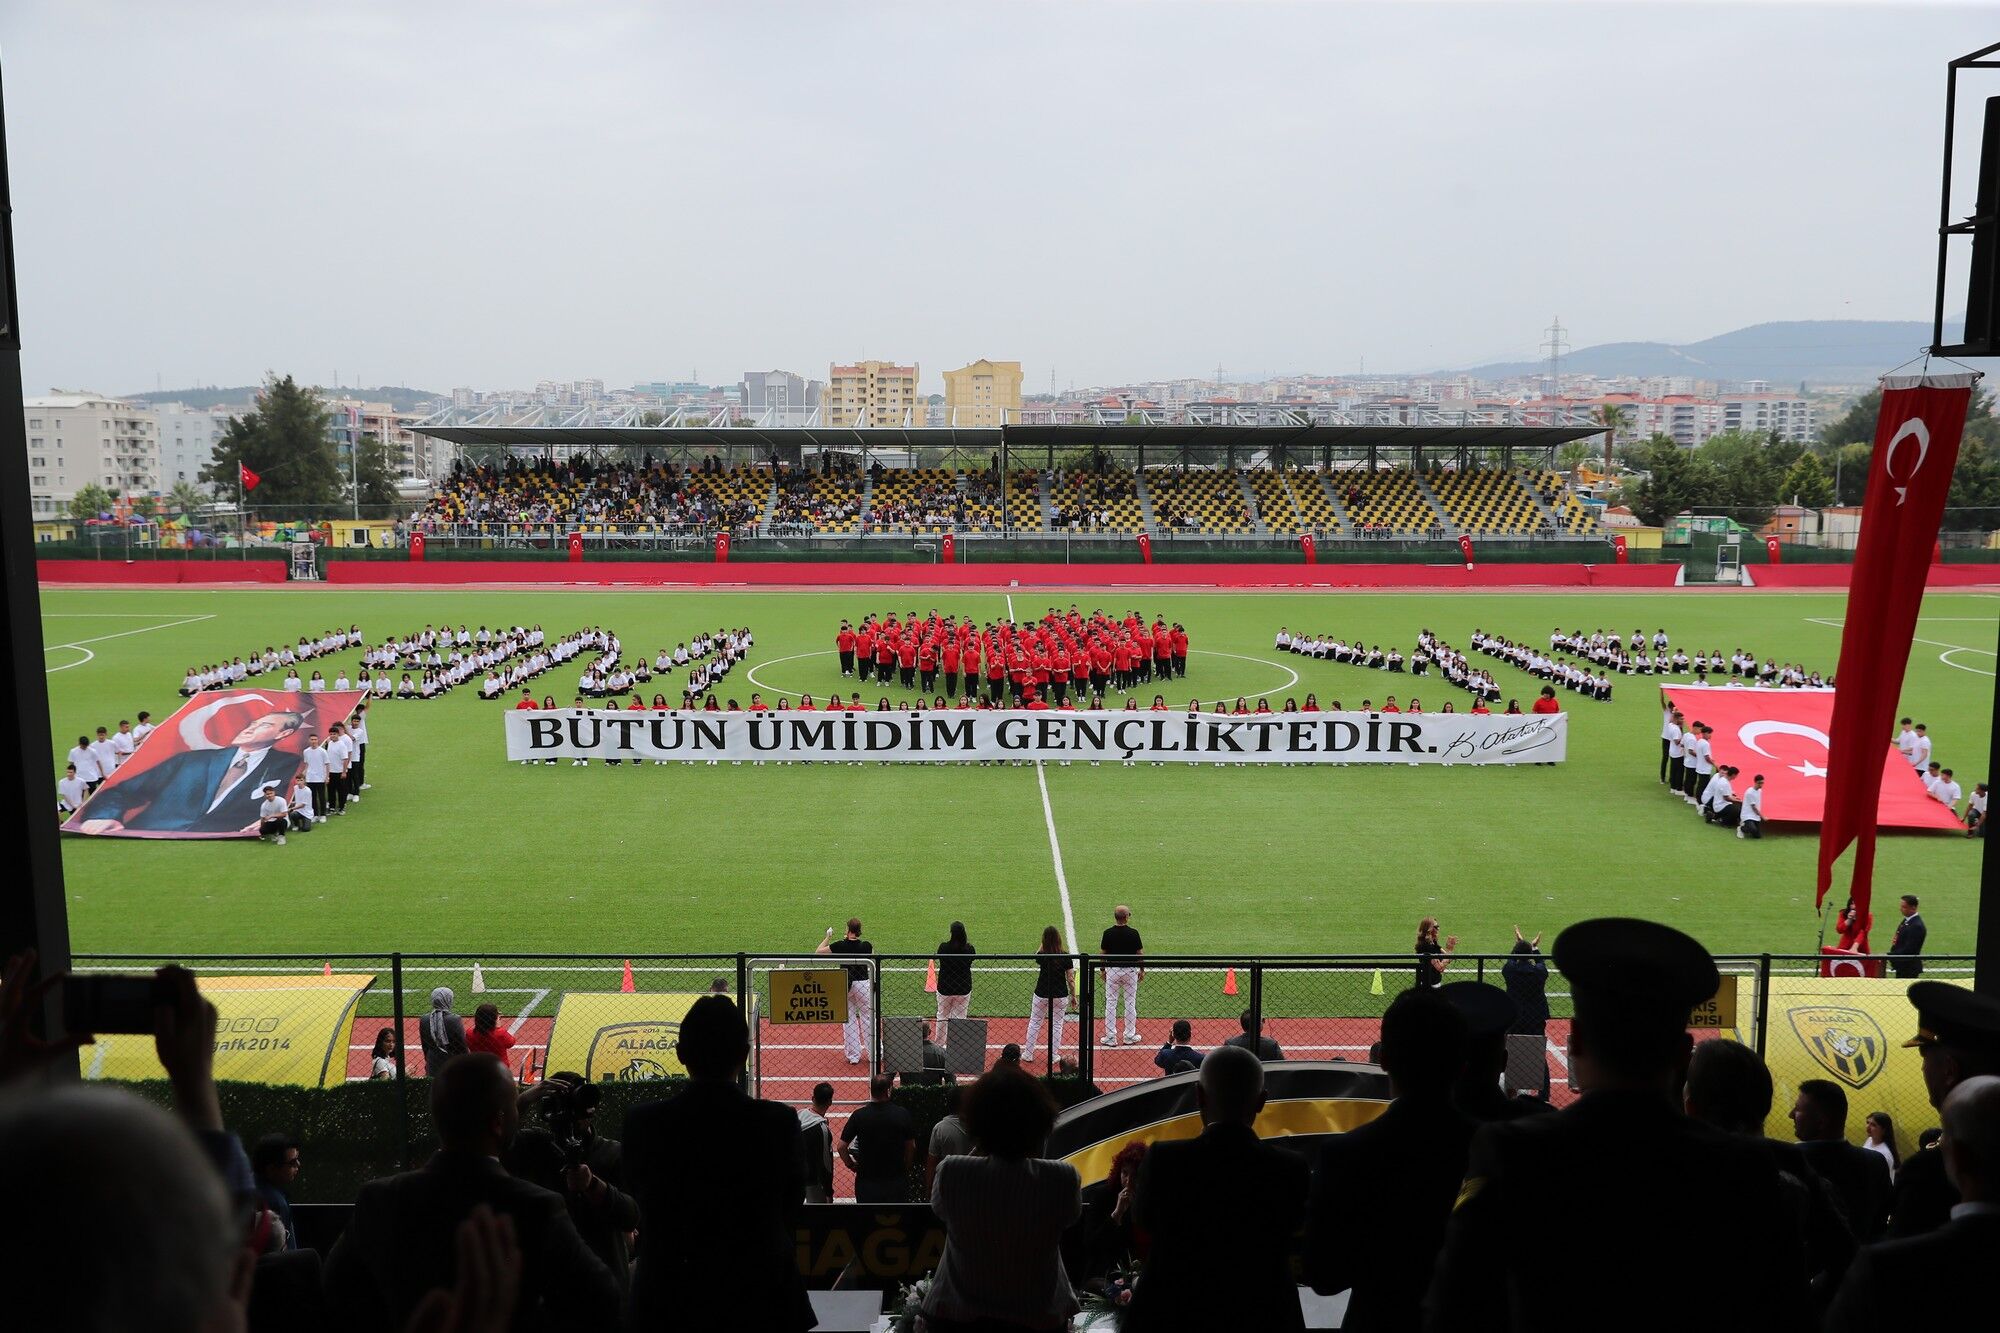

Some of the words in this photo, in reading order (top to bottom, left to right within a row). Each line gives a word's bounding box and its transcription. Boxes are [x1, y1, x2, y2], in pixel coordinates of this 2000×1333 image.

[527, 711, 728, 750] BÜTÜN
[746, 711, 977, 752] ÜMİDİM
[995, 713, 1438, 759] GENÇLİKTEDİR.
[791, 981, 826, 995] ACİL
[790, 997, 829, 1010] ÇIKIŞ
[785, 1010, 834, 1021] KAPISI
